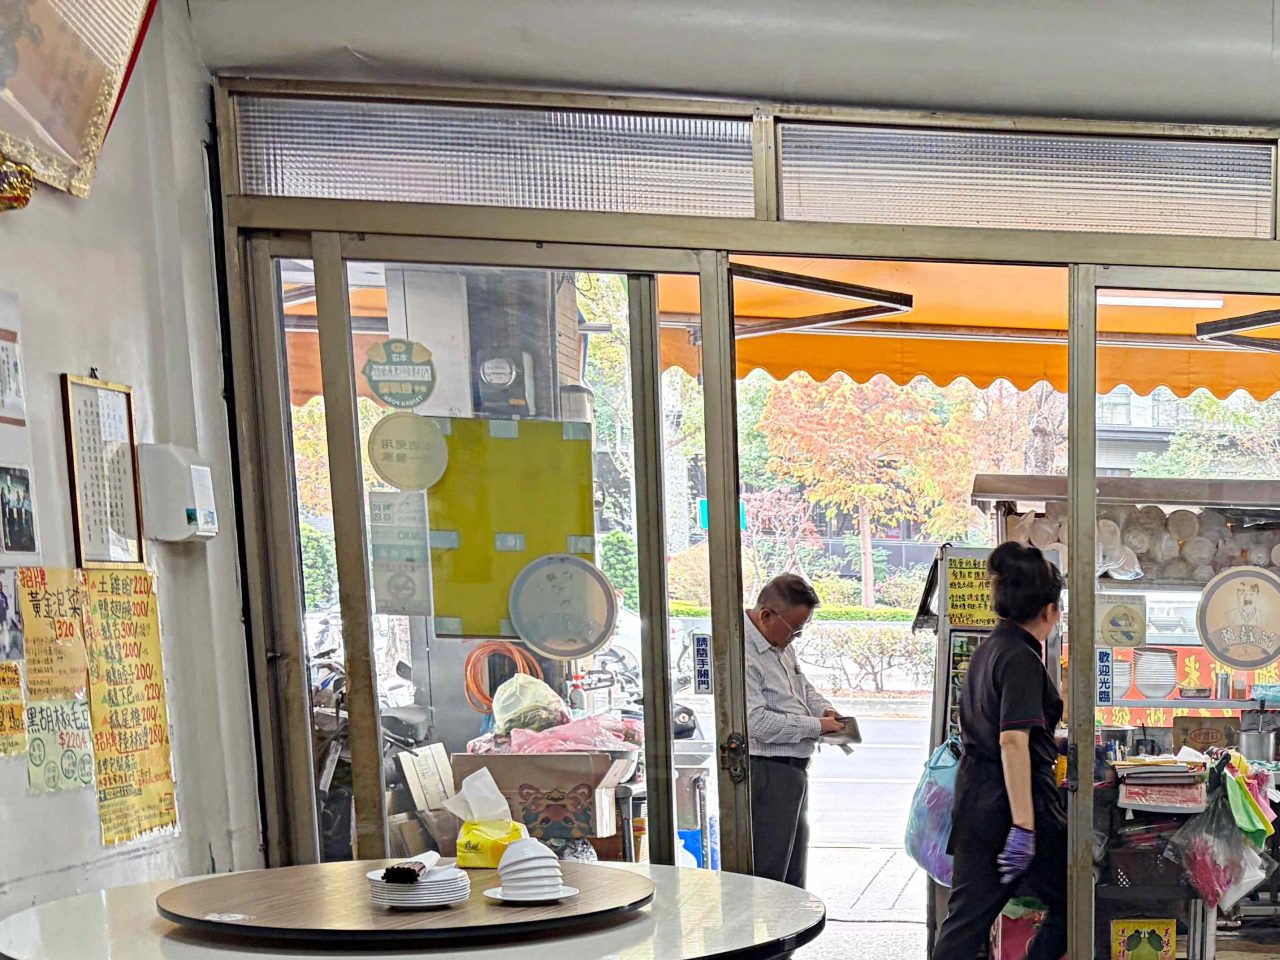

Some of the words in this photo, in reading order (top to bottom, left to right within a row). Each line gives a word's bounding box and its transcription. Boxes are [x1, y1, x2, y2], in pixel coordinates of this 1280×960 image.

[19, 567, 47, 590] 招牌
[28, 586, 81, 619] 黃金泡菜
[696, 637, 710, 690] 請隨手關門
[1098, 651, 1111, 704] 歡迎光臨
